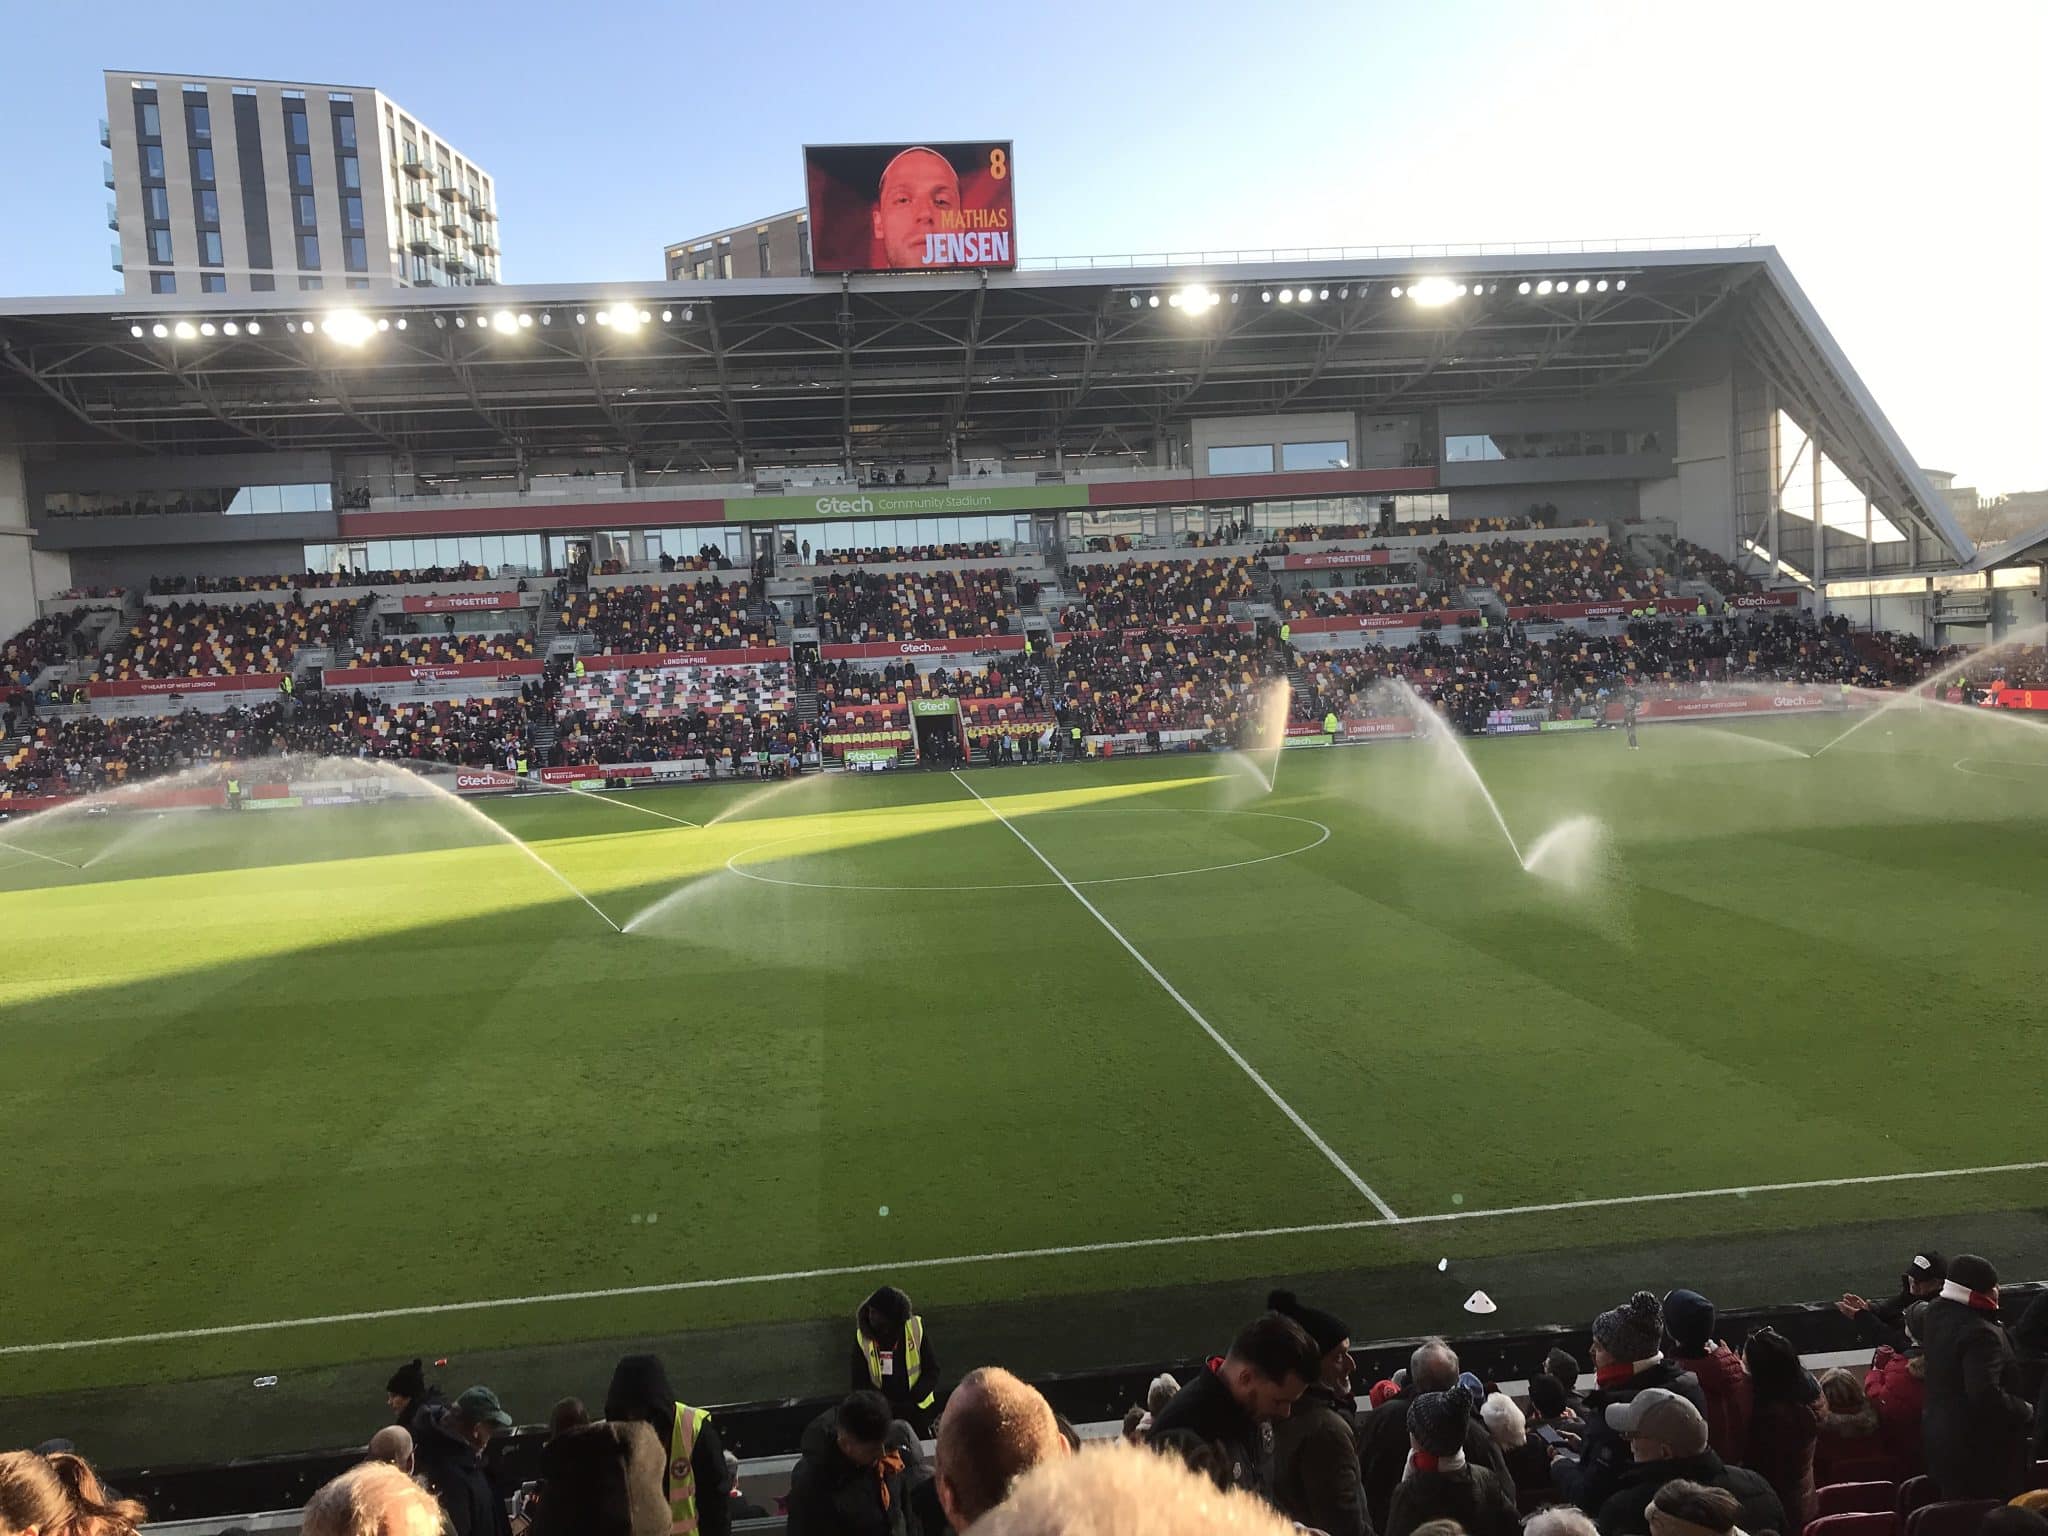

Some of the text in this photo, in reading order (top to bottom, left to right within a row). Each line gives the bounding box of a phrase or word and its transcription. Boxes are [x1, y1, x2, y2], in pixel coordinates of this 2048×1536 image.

[990, 148, 1006, 180] 8
[940, 208, 1007, 229] MATHIAS
[922, 231, 1009, 264] JENSEN
[815, 494, 992, 514] Gtech Community Stadium
[689, 656, 708, 664] PRIDE
[918, 701, 950, 711] Gtech
[1349, 726, 1375, 734] LONDON
